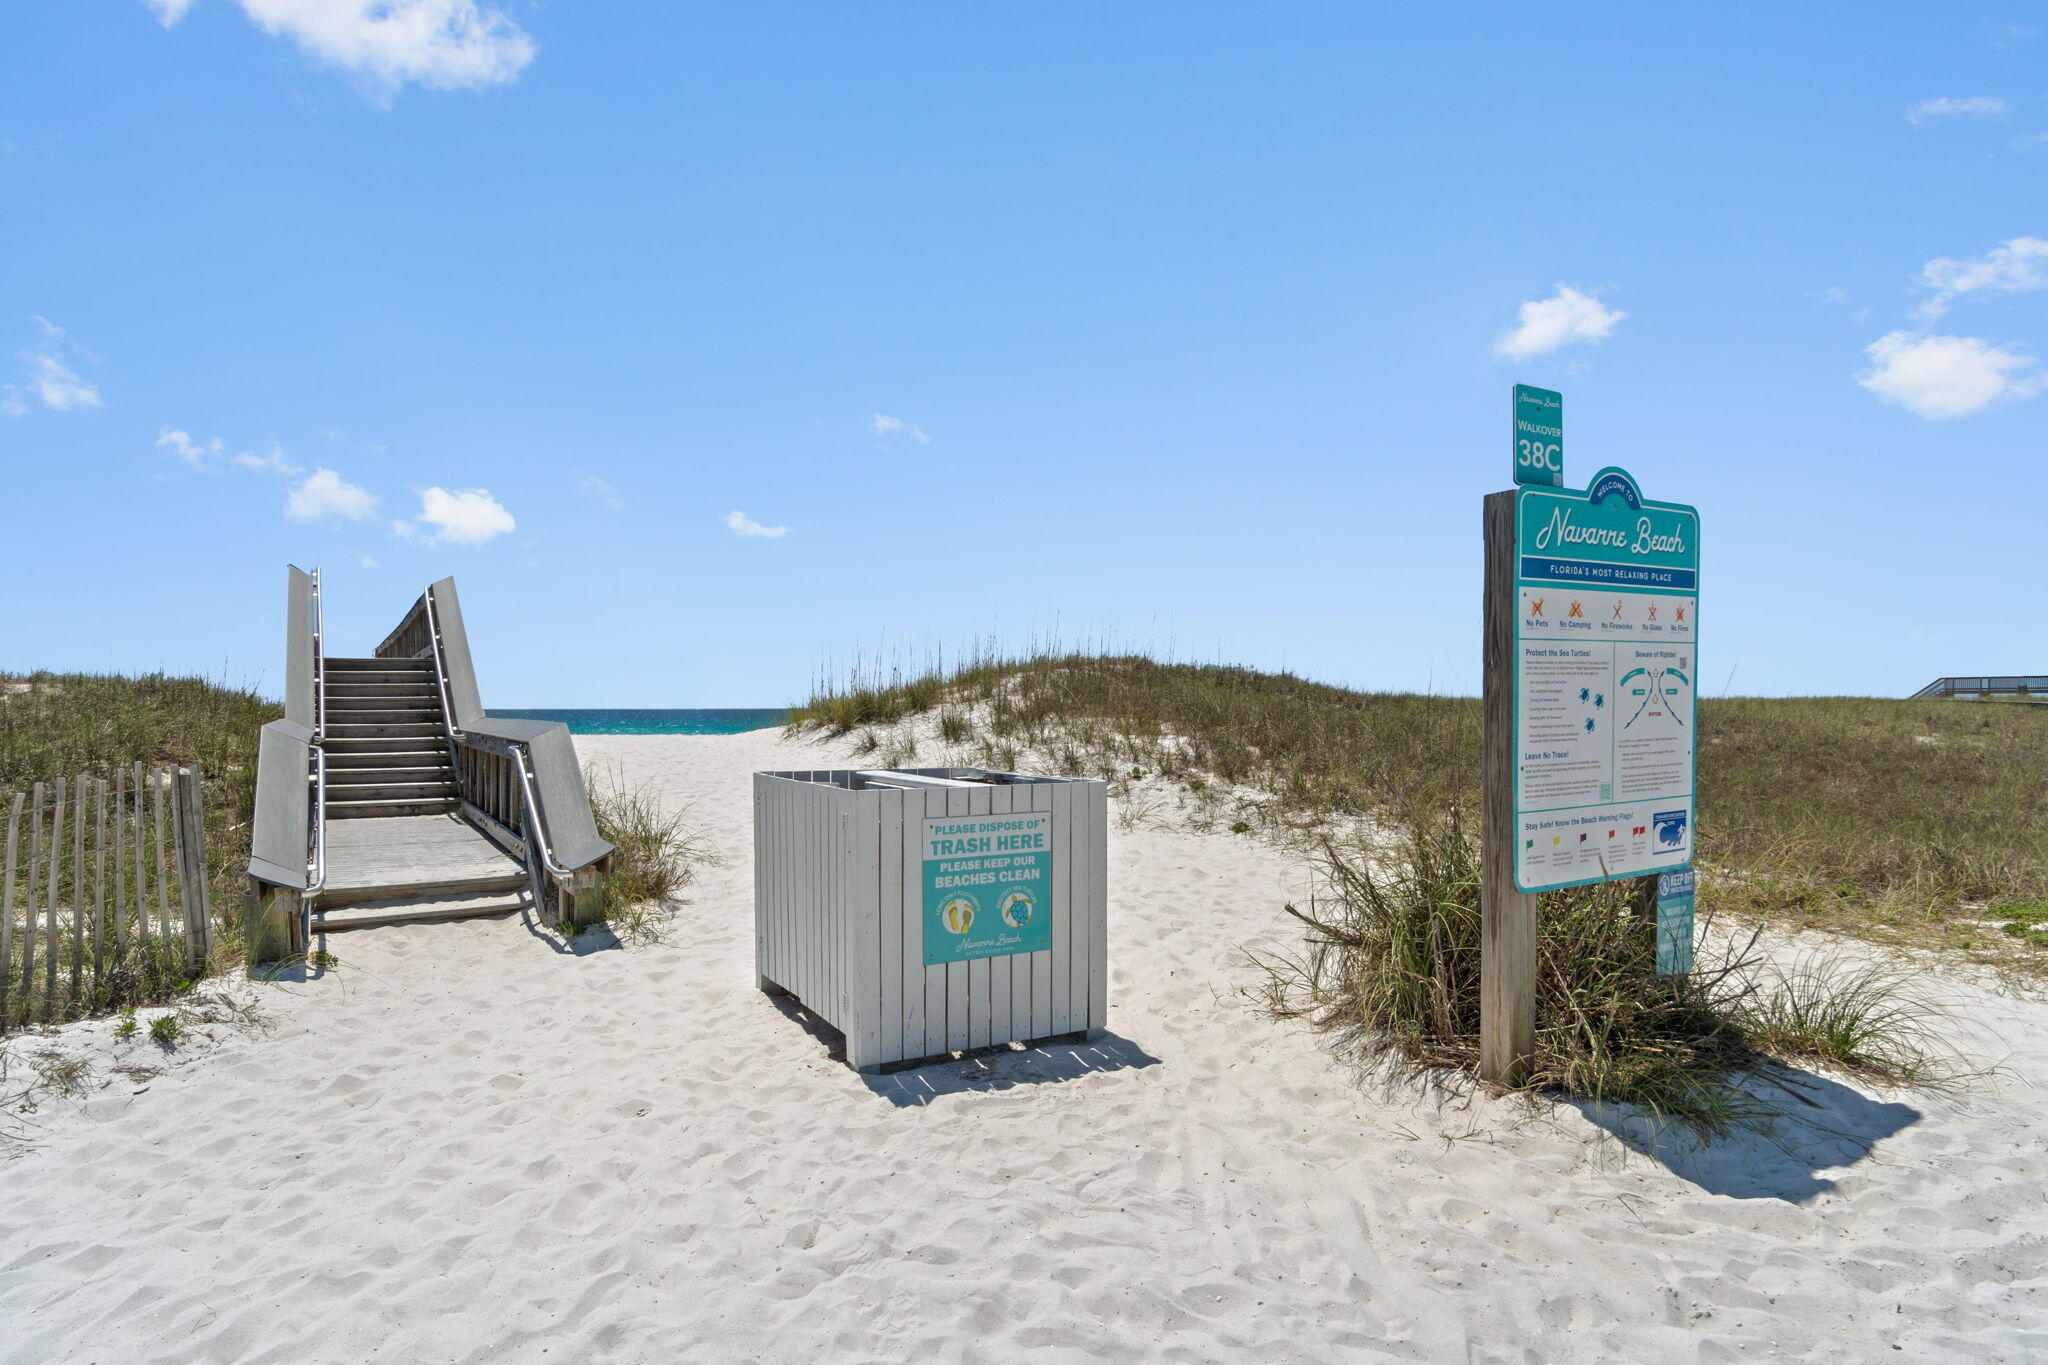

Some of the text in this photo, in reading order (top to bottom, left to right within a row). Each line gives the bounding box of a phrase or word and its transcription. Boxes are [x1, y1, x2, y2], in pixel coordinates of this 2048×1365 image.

[1544, 397, 1560, 408] Beach
[1518, 420, 1562, 437] WALKOVER
[1519, 440, 1560, 472] 38C
[1597, 482, 1634, 502] WELCOME TO
[1536, 506, 1685, 555] Navarre Beach
[1550, 565, 1672, 582] FLORIDA'S MOST RELAXING PLACE
[1560, 620, 1591, 630] No Camping
[1526, 648, 1547, 657] Protect
[1659, 650, 1676, 658] Riptide!
[935, 820, 1040, 836] PLEASE DISPOSE OF
[1526, 823, 1538, 831] Stay
[1540, 820, 1554, 829] Safe!
[1598, 814, 1618, 823] Warning
[1619, 812, 1634, 821] Flags!
[930, 833, 1044, 856] TRASH HERE
[940, 856, 1036, 872] PLEASE KEEP OUR
[935, 868, 1040, 889] BEACHES CLEAN
[1670, 872, 1693, 886] KEEP OFF
[944, 892, 957, 900] ONLY
[995, 888, 1012, 909] PROTECT
[956, 933, 1022, 952] Navarre Beach
